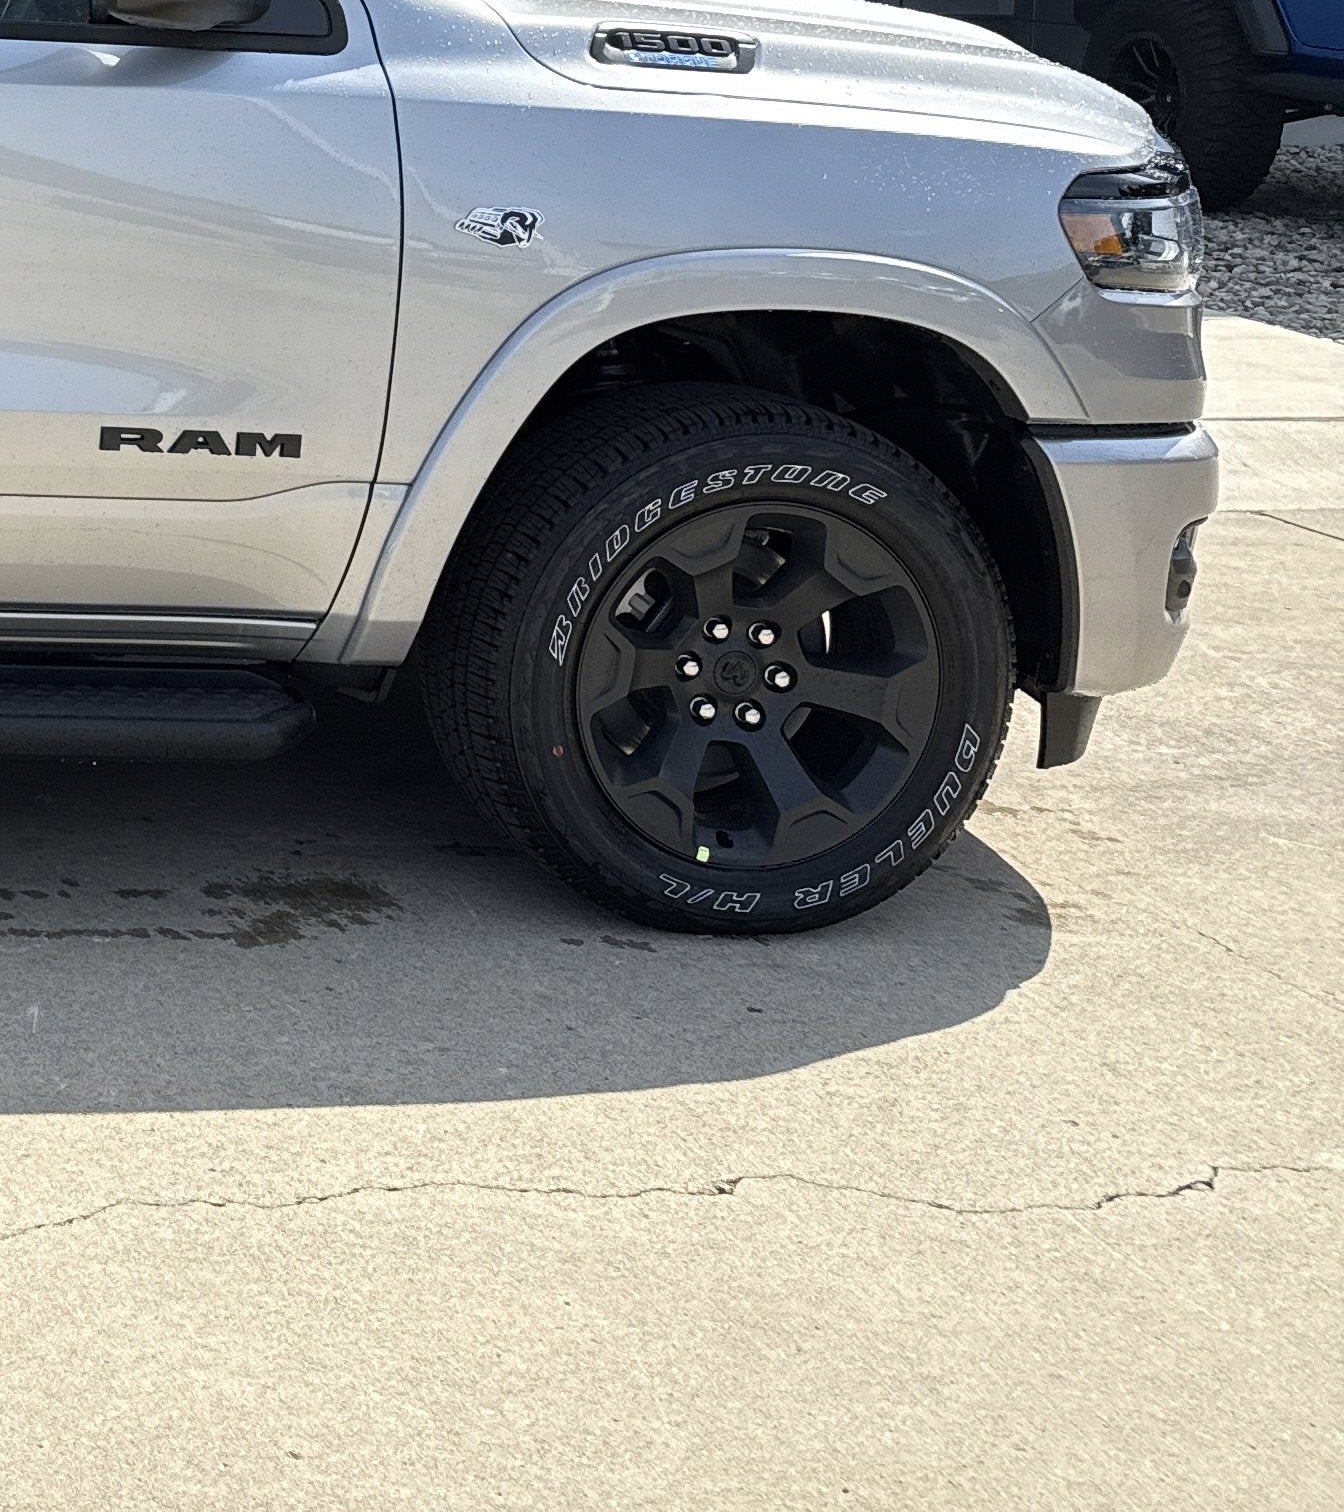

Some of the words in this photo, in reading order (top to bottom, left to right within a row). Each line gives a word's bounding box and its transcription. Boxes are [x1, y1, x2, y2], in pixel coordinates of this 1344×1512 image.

[615, 31, 734, 55] 1500
[99, 426, 302, 458] RAM
[549, 464, 888, 666] BRIDGESTONE
[794, 723, 980, 909] DUELER
[659, 873, 761, 912] H/L
